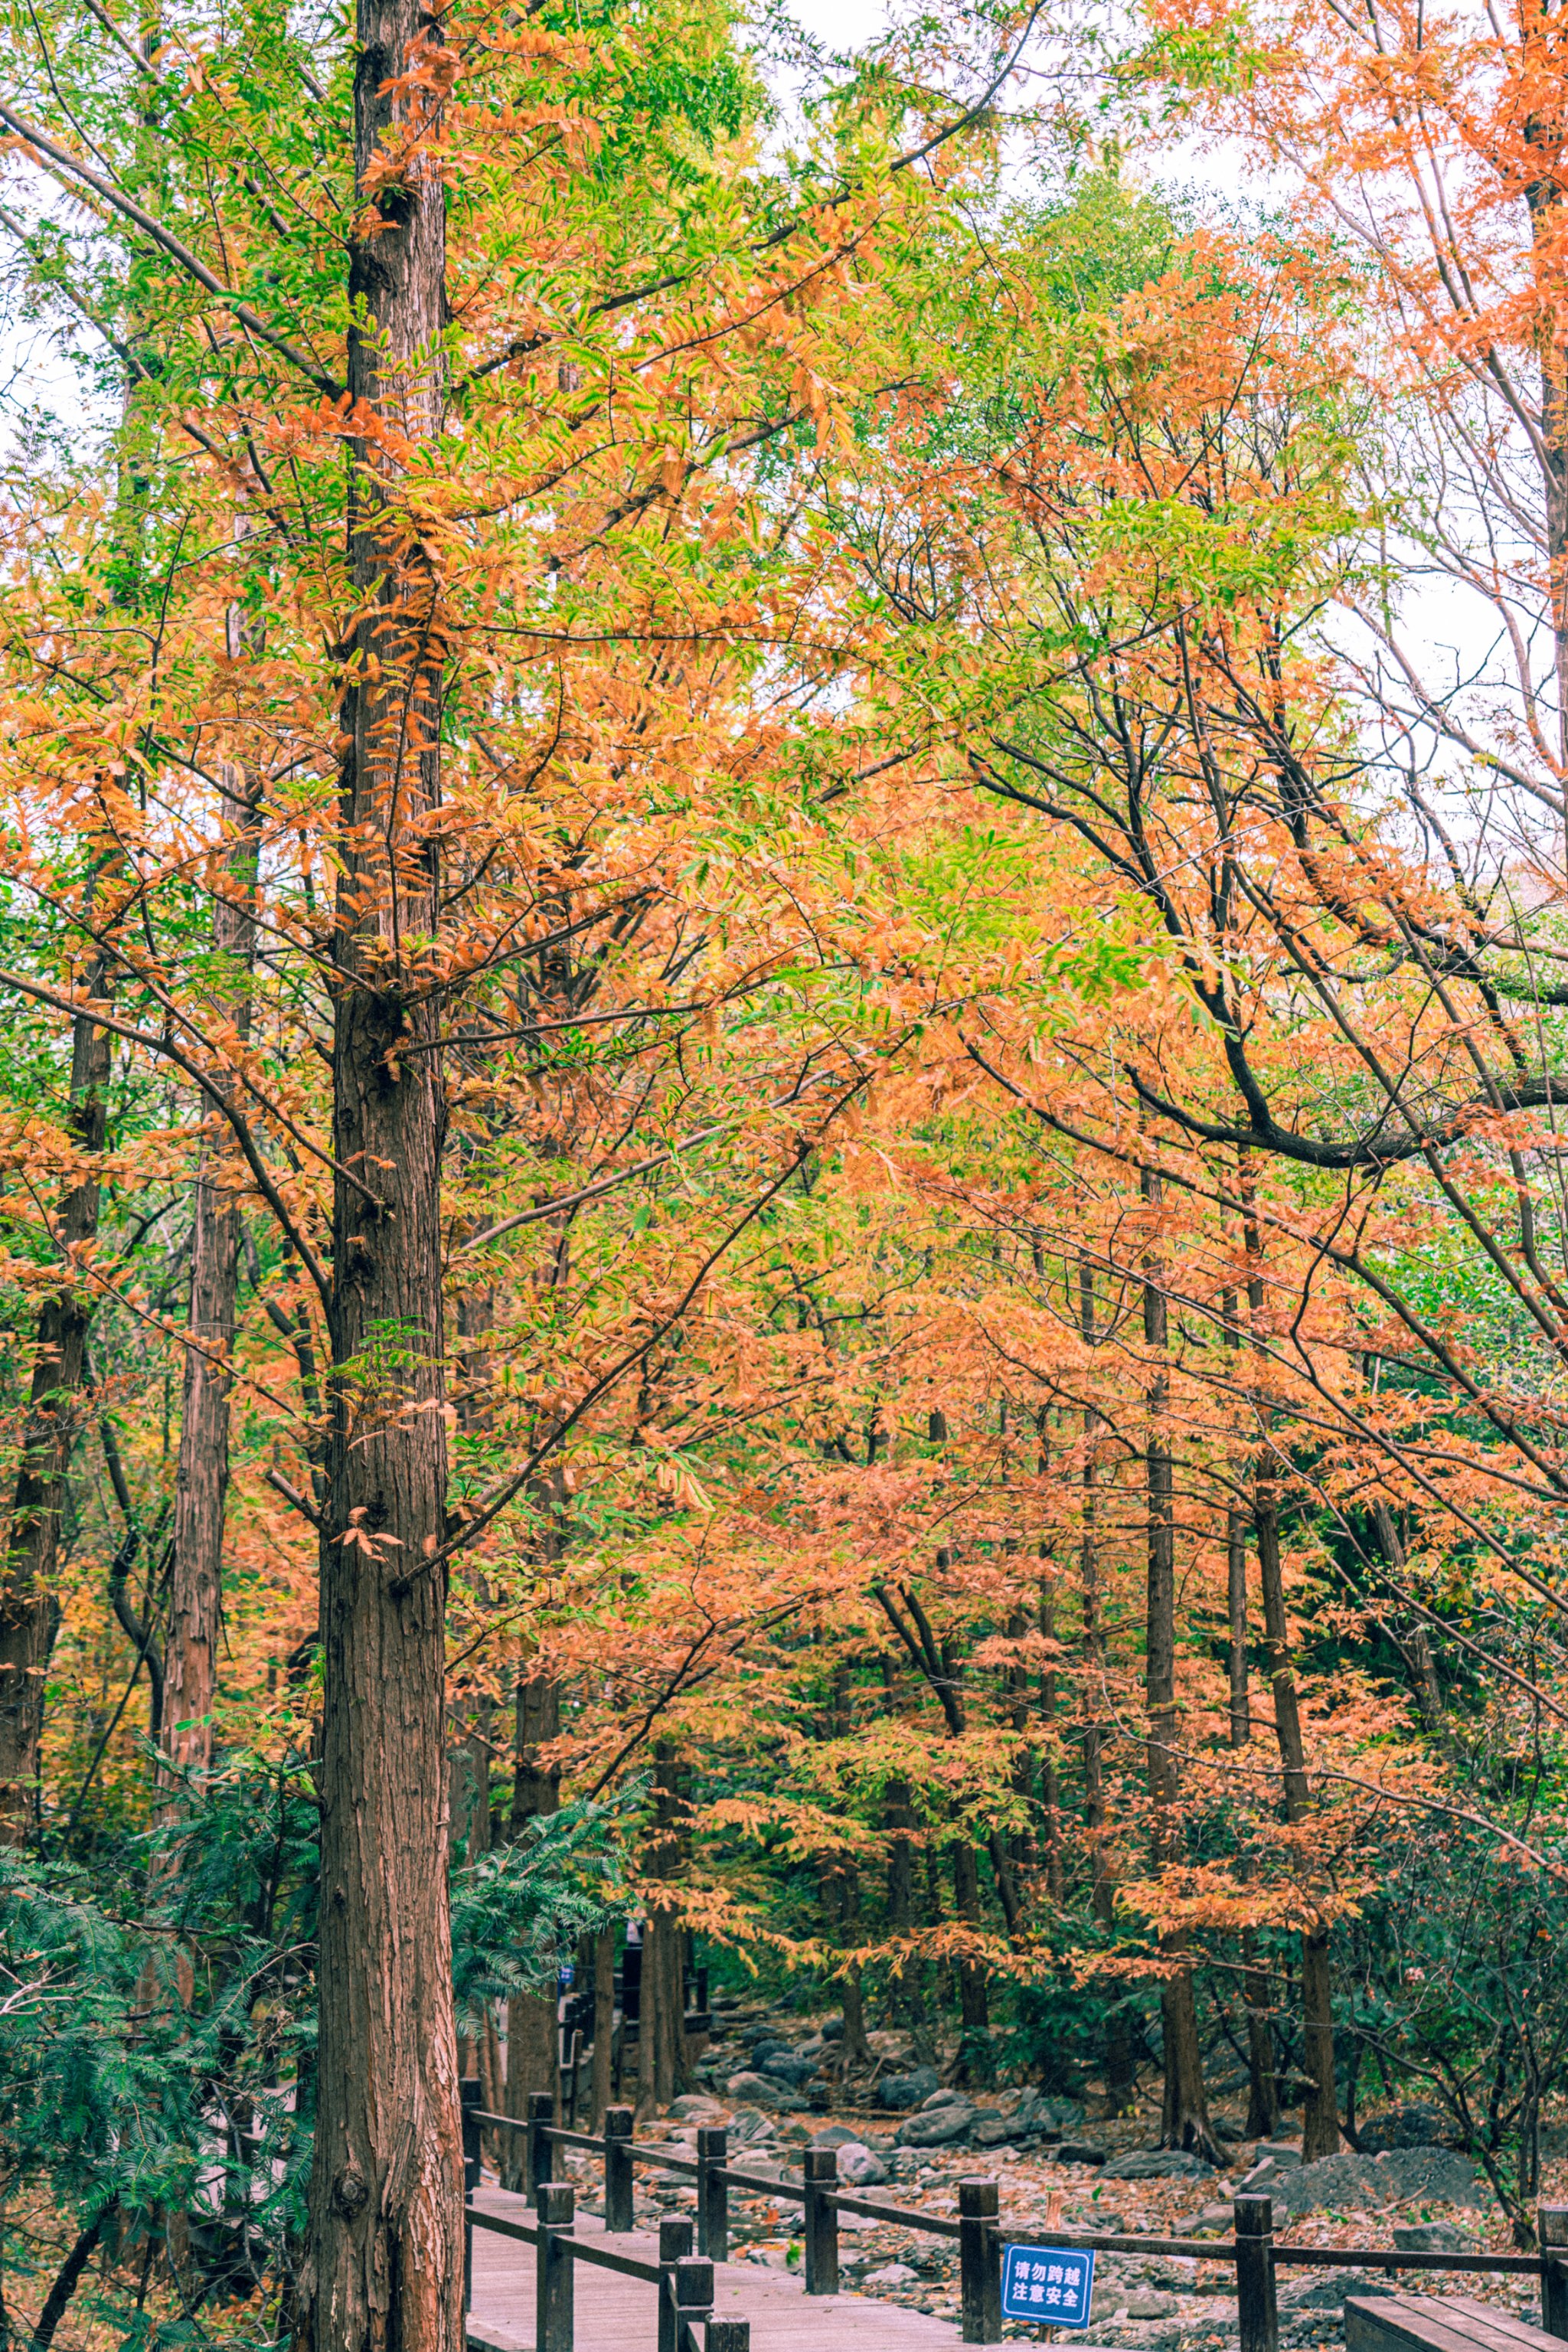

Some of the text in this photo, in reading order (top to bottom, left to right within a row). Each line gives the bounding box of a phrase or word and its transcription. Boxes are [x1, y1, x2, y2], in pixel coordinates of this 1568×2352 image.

[1014, 2261, 1081, 2286] 请勿跨越
[1012, 2282, 1079, 2308] 注意安全
